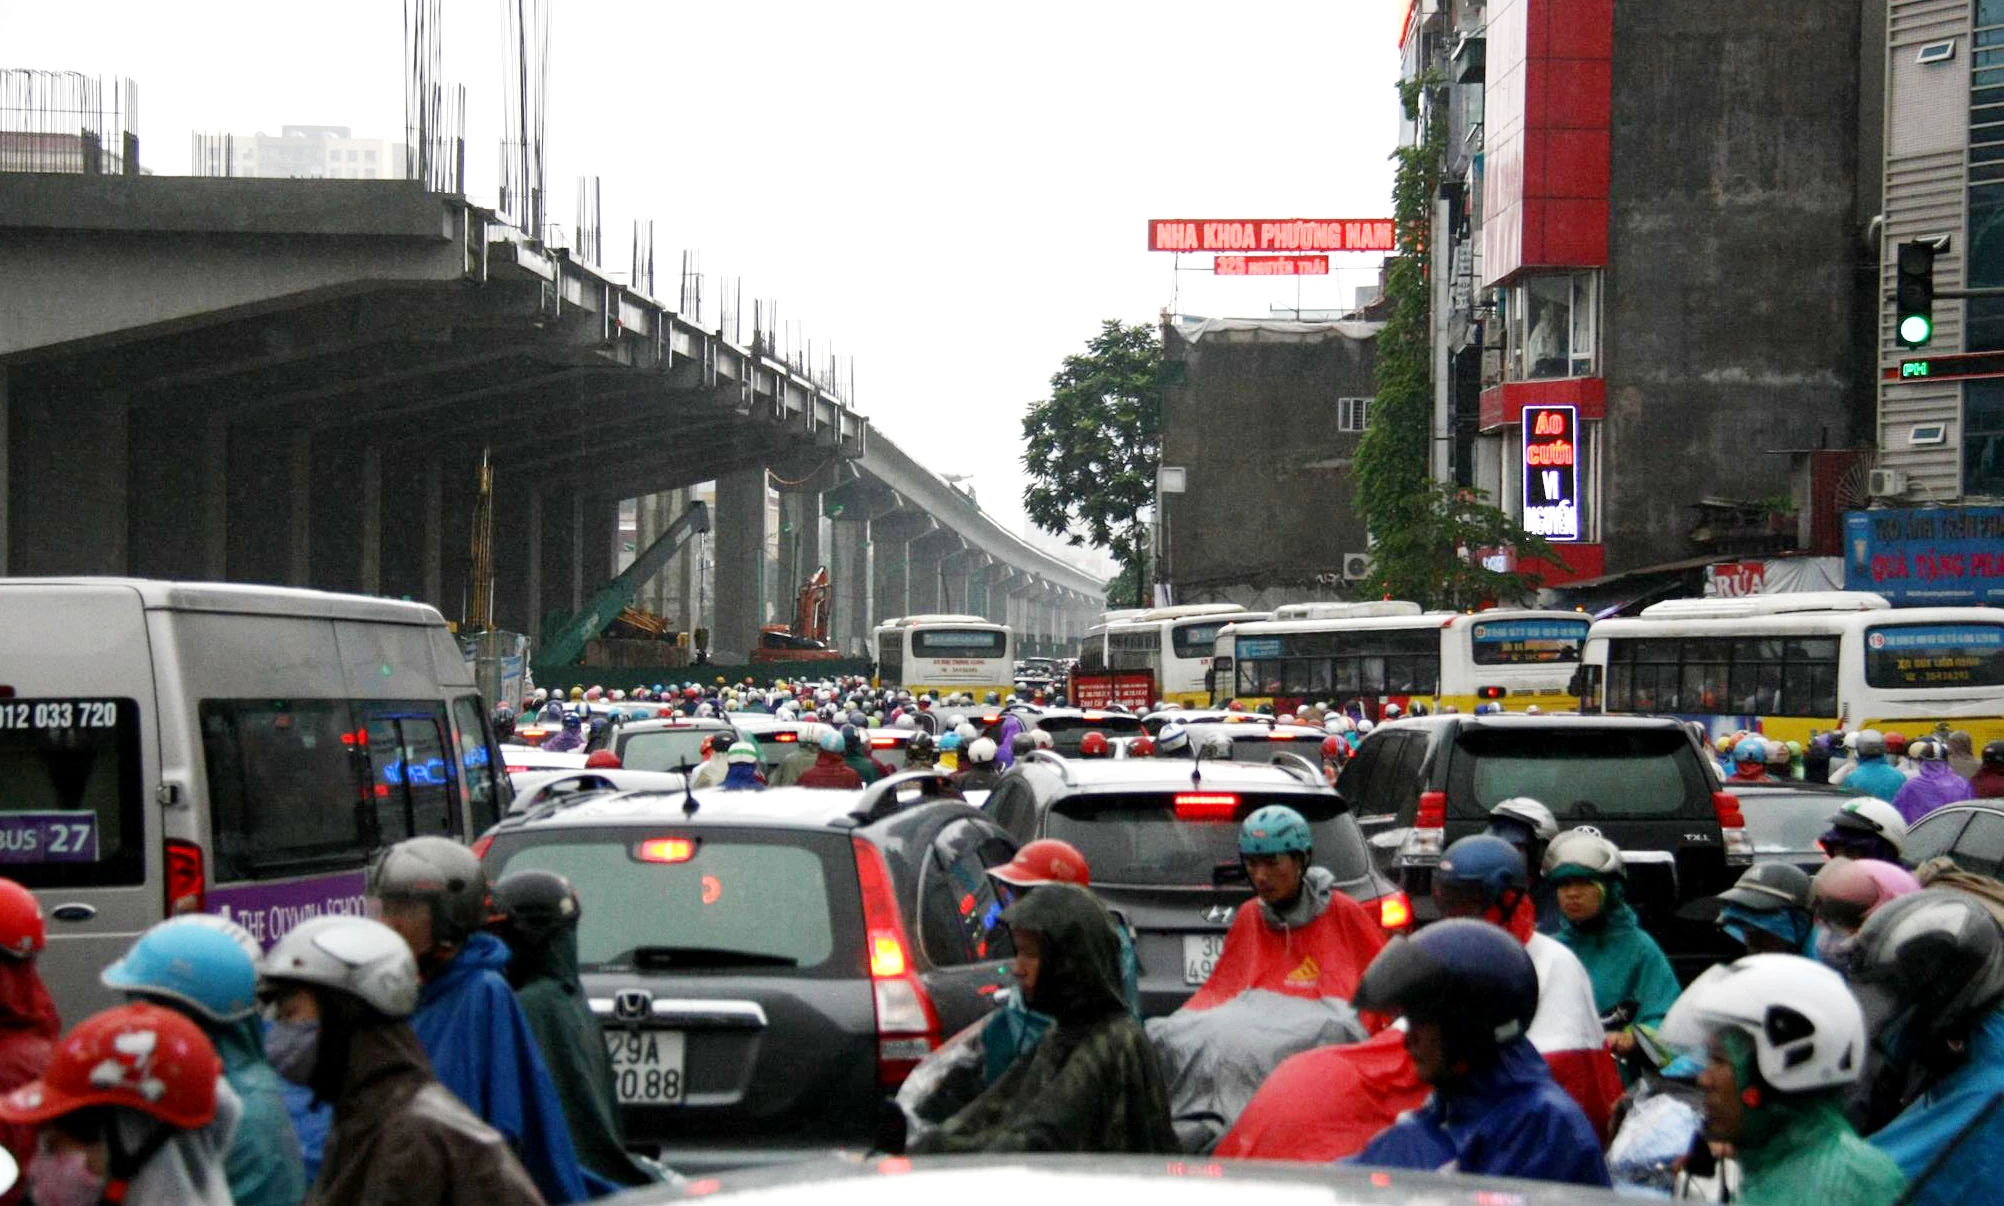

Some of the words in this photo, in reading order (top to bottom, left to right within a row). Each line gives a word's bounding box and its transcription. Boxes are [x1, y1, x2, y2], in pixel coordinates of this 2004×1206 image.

[1157, 223, 1198, 249] NHA
[1203, 223, 1256, 249] KHOA
[1346, 222, 1392, 249] NAM
[1902, 362, 1927, 377] PH
[1535, 410, 1563, 435] ÁO
[1526, 440, 1573, 465] CƯỚI
[1541, 470, 1559, 500] VI
[34, 703, 73, 728] 033
[78, 702, 117, 728] 720
[49, 823, 91, 852] 27
[238, 909, 266, 942] THE
[1202, 936, 1224, 957] 30
[1189, 960, 1212, 980] 49
[606, 1035, 660, 1065] 29A
[612, 1068, 680, 1100] 0.88
